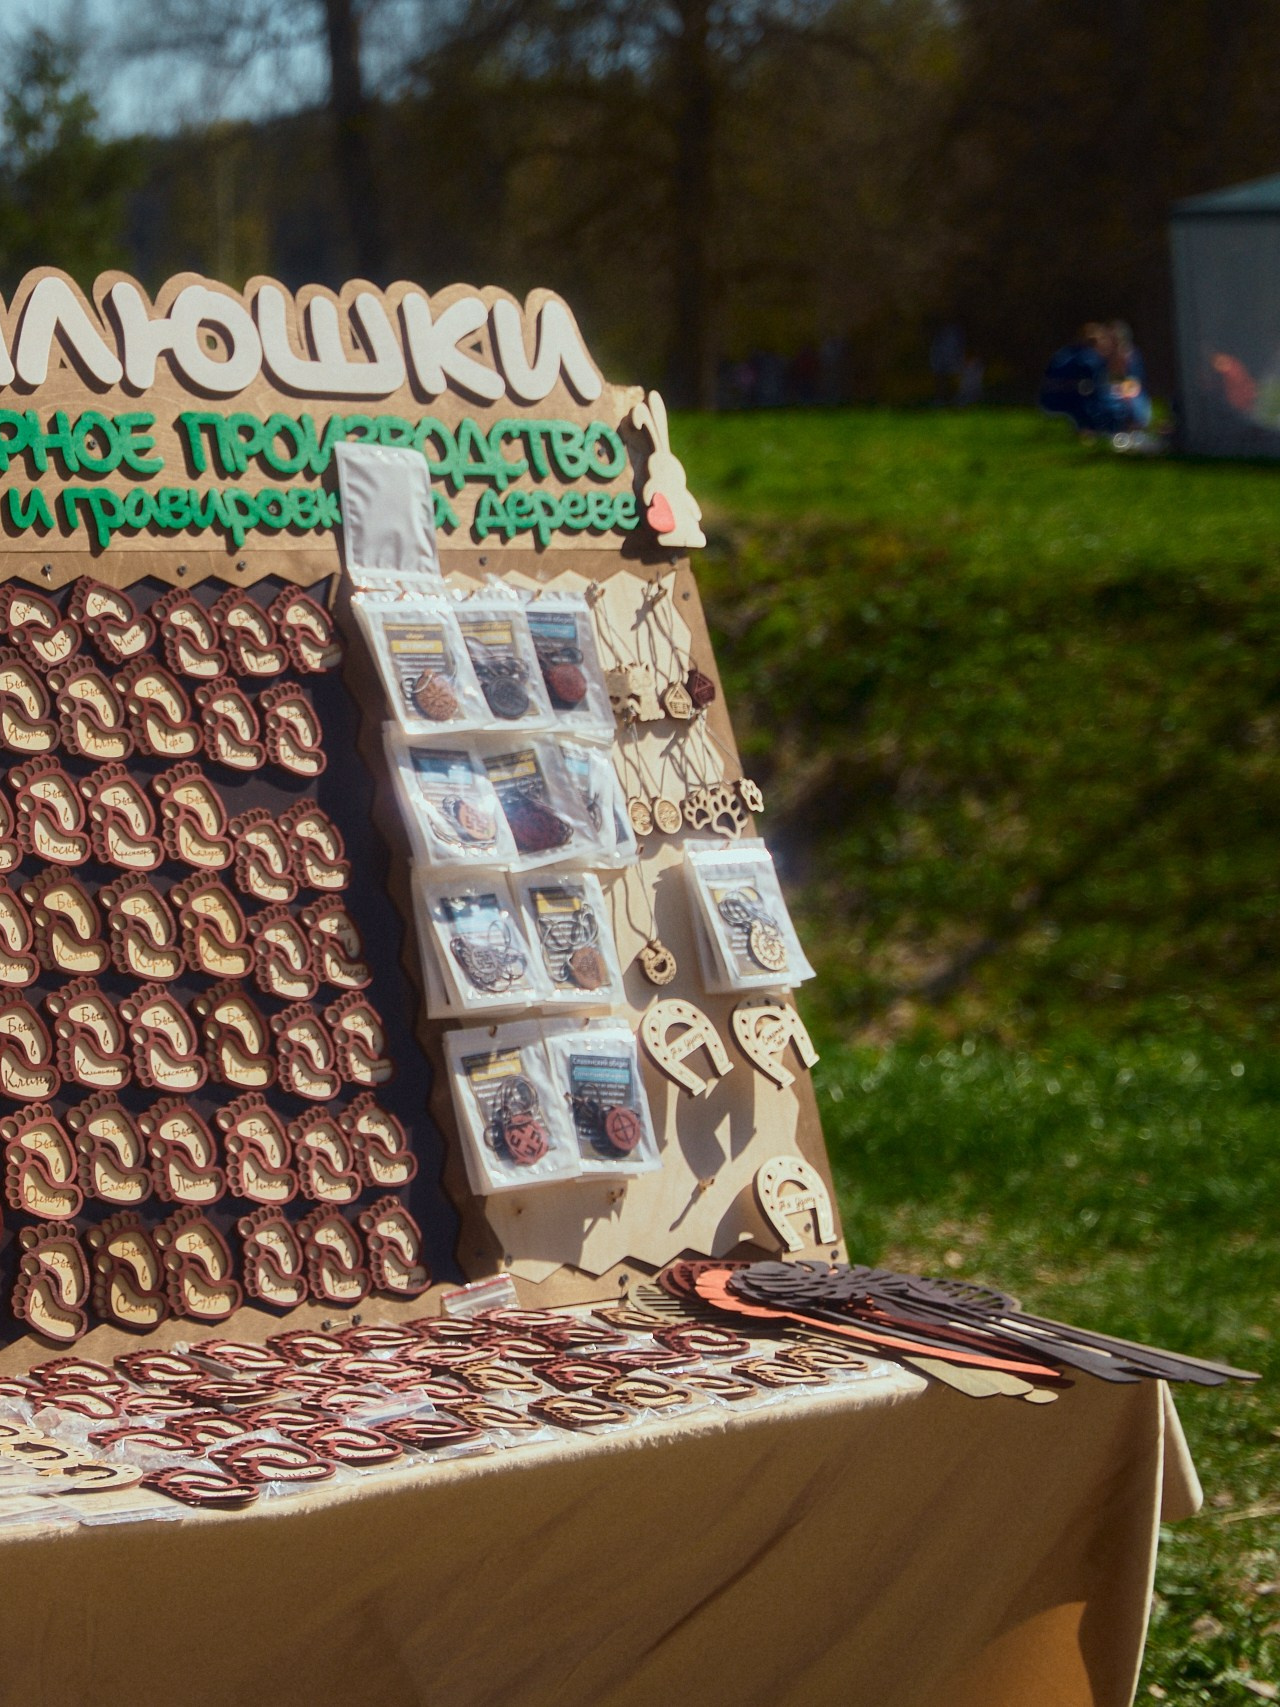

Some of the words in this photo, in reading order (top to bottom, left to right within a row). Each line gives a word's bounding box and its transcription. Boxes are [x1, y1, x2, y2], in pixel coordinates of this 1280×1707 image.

[8, 487, 54, 528] и
[62, 487, 342, 548] гравировк
[475, 488, 639, 546] дереве
[16, 600, 32, 620] Был
[93, 594, 110, 611] Был
[5, 675, 31, 689] Был
[80, 680, 107, 695] Был
[145, 681, 167, 696] Был
[42, 784, 68, 798] Был
[112, 791, 137, 804] Был
[185, 791, 210, 804] Был
[40, 835, 82, 853] Москве
[57, 894, 83, 907] Был
[134, 900, 159, 914] Был
[203, 898, 226, 912] Был
[81, 1007, 109, 1020] Был
[152, 1011, 176, 1026] Был
[8, 1018, 34, 1032] Был
[100, 1120, 128, 1135] Был
[171, 1123, 198, 1138] Был
[249, 1122, 274, 1136] Был
[33, 1134, 60, 1148] Был
[121, 1241, 146, 1256] Был
[188, 1235, 214, 1251] Был
[50, 1252, 77, 1269] Был
